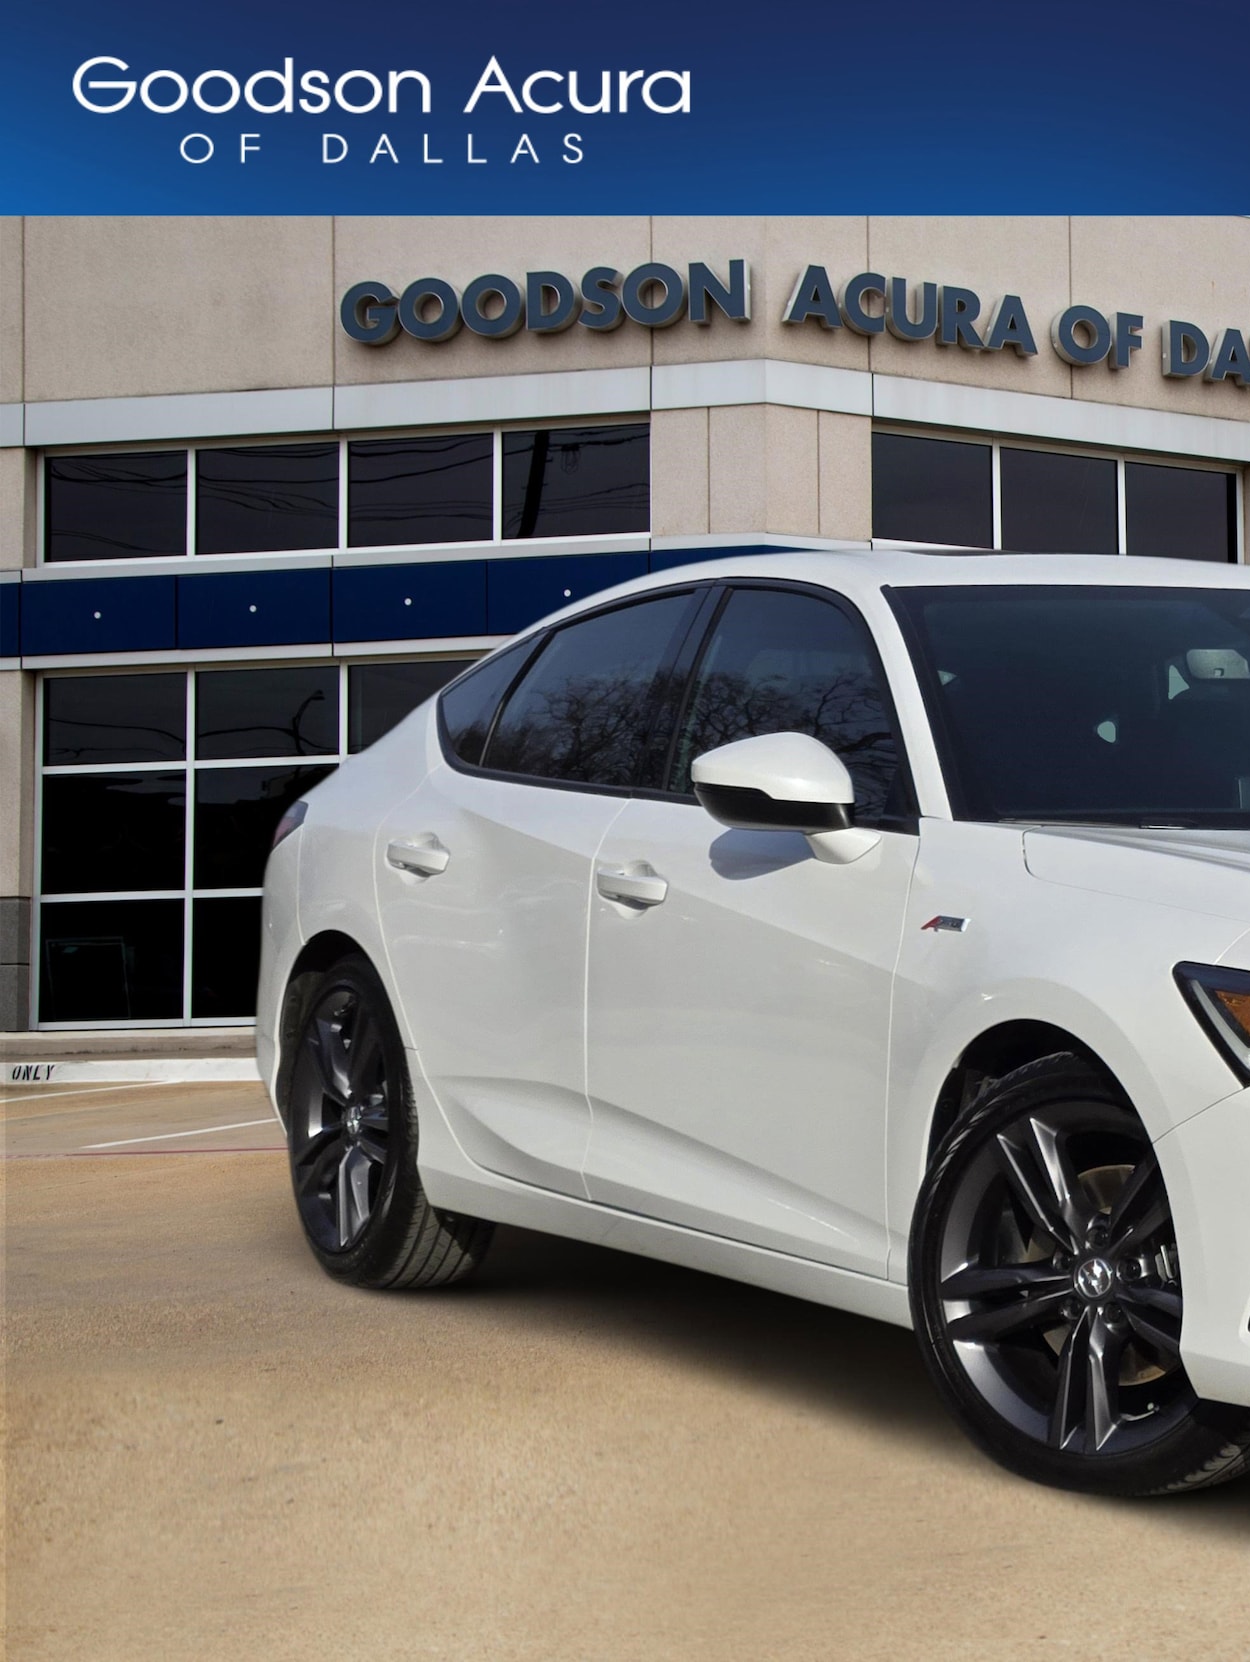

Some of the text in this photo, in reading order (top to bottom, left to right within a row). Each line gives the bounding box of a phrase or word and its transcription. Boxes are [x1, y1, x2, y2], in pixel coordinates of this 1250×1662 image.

[340, 259, 750, 345] GOODSON
[782, 264, 1038, 356] ACURA
[1052, 305, 1144, 370] OF
[11, 1064, 55, 1081] ONLY
